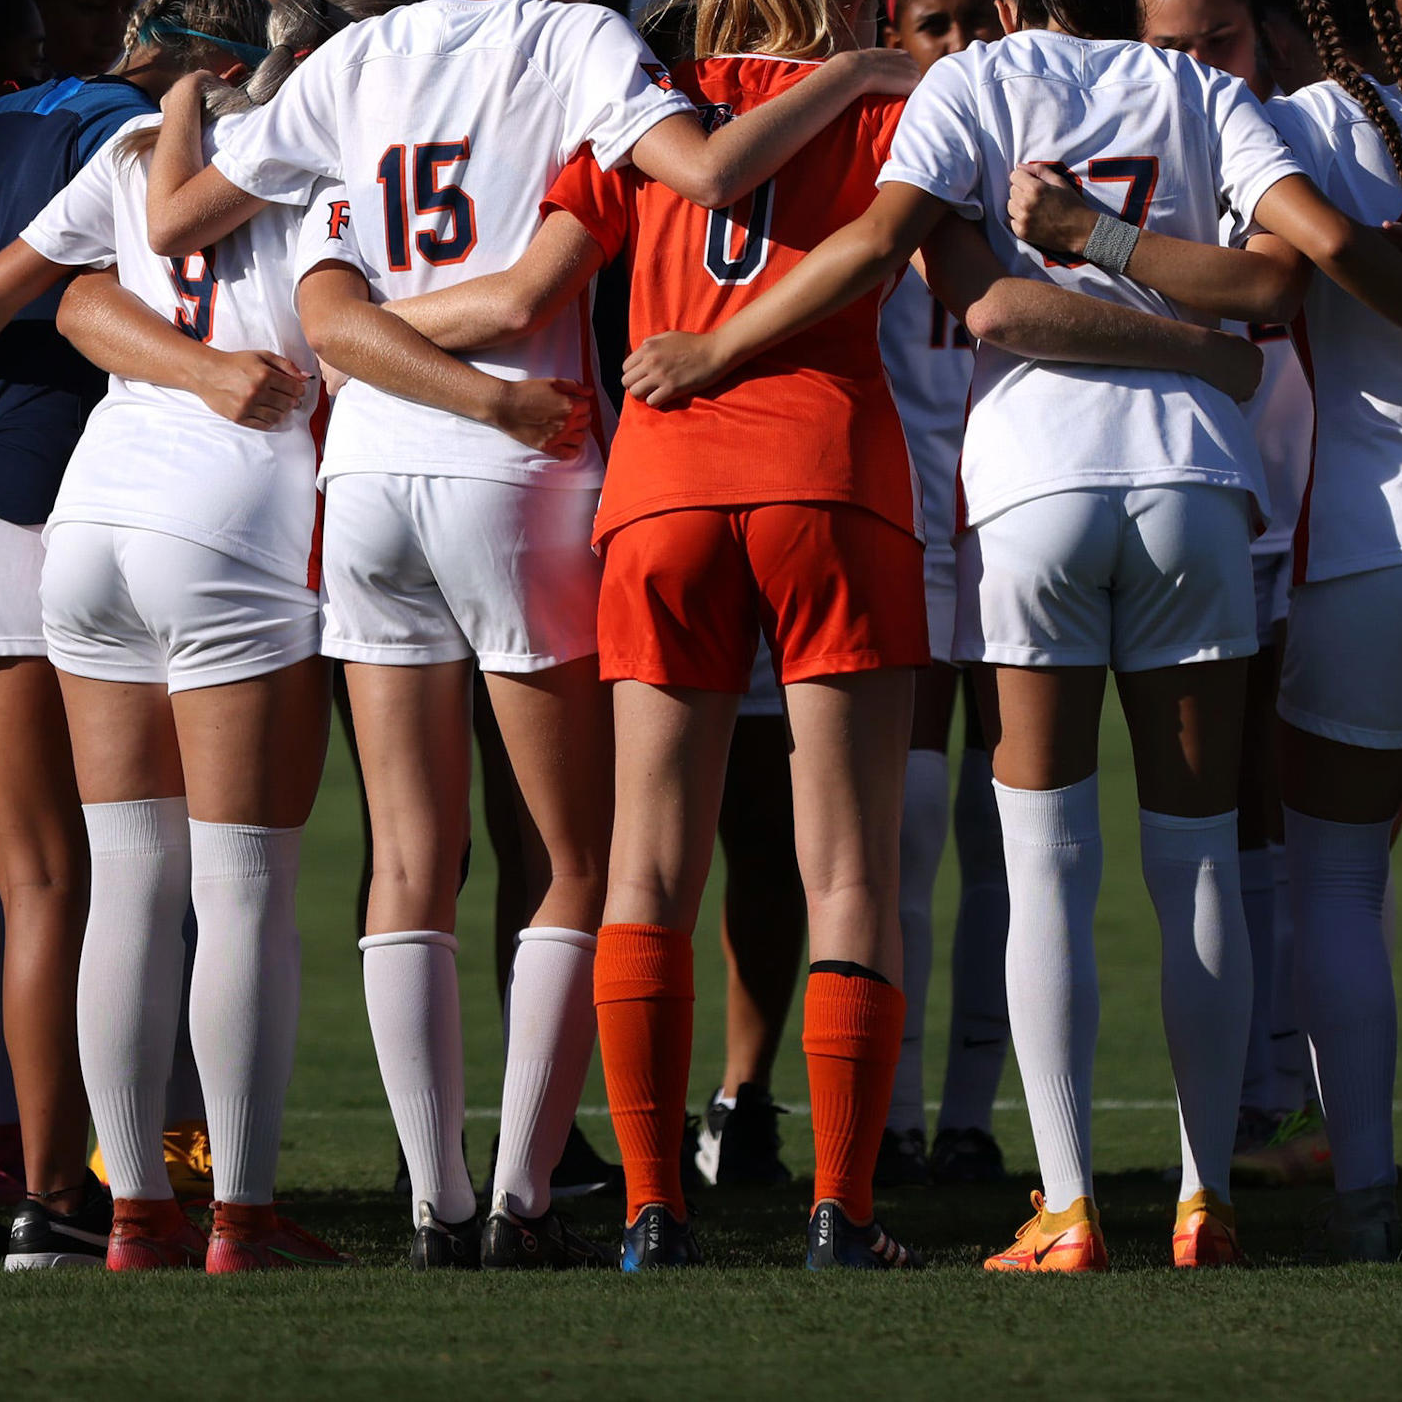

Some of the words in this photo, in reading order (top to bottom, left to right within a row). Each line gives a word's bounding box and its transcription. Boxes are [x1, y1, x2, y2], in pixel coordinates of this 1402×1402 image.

[325, 200, 350, 242] F
[377, 136, 477, 272] 15
[649, 1214, 660, 1250] COPA
[818, 1210, 829, 1247] COPA
